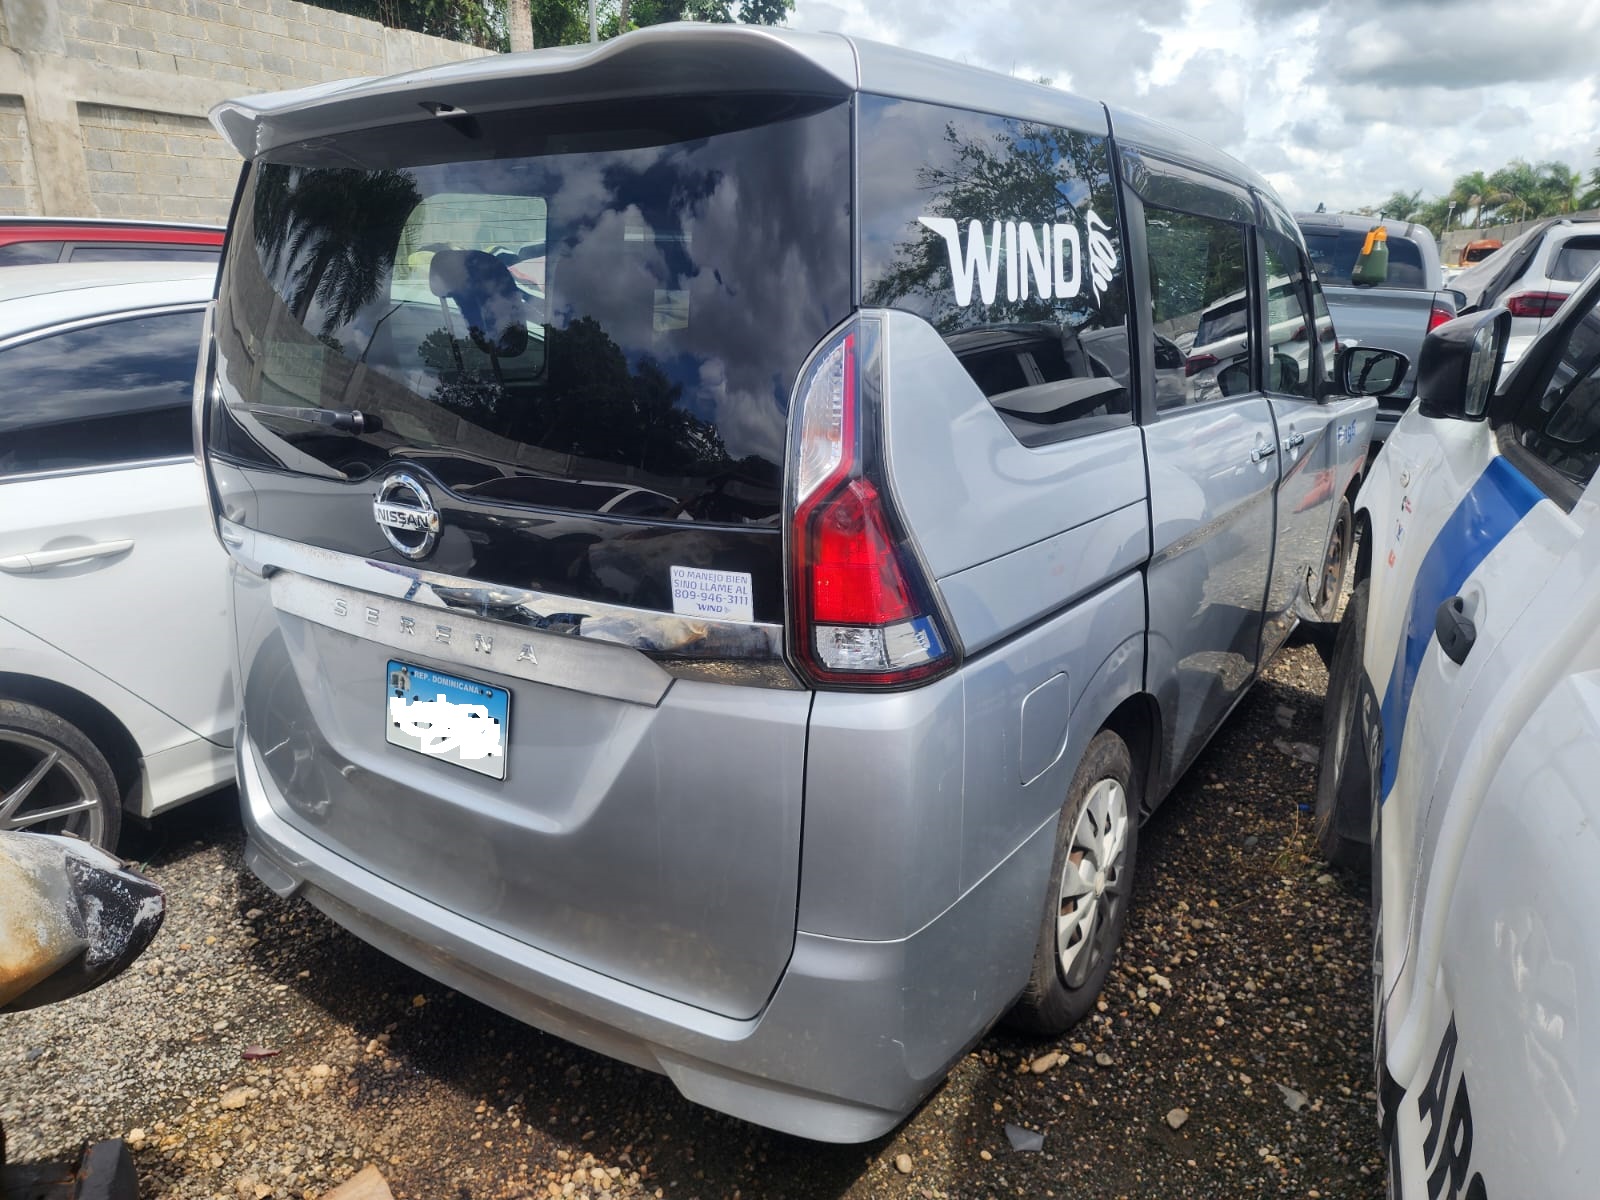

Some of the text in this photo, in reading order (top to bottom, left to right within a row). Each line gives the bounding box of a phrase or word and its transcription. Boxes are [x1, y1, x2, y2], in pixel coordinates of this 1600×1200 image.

[917, 216, 1081, 306] WIND
[377, 508, 428, 528] NISSAN
[674, 570, 748, 585] YO MANEJO BIEN
[674, 579, 748, 595] SINO LLAME AL
[674, 589, 748, 605] 809-946-3111
[697, 603, 723, 613] WIND
[334, 598, 538, 665] SERENA
[414, 670, 480, 694] REP. DOMINICANA
